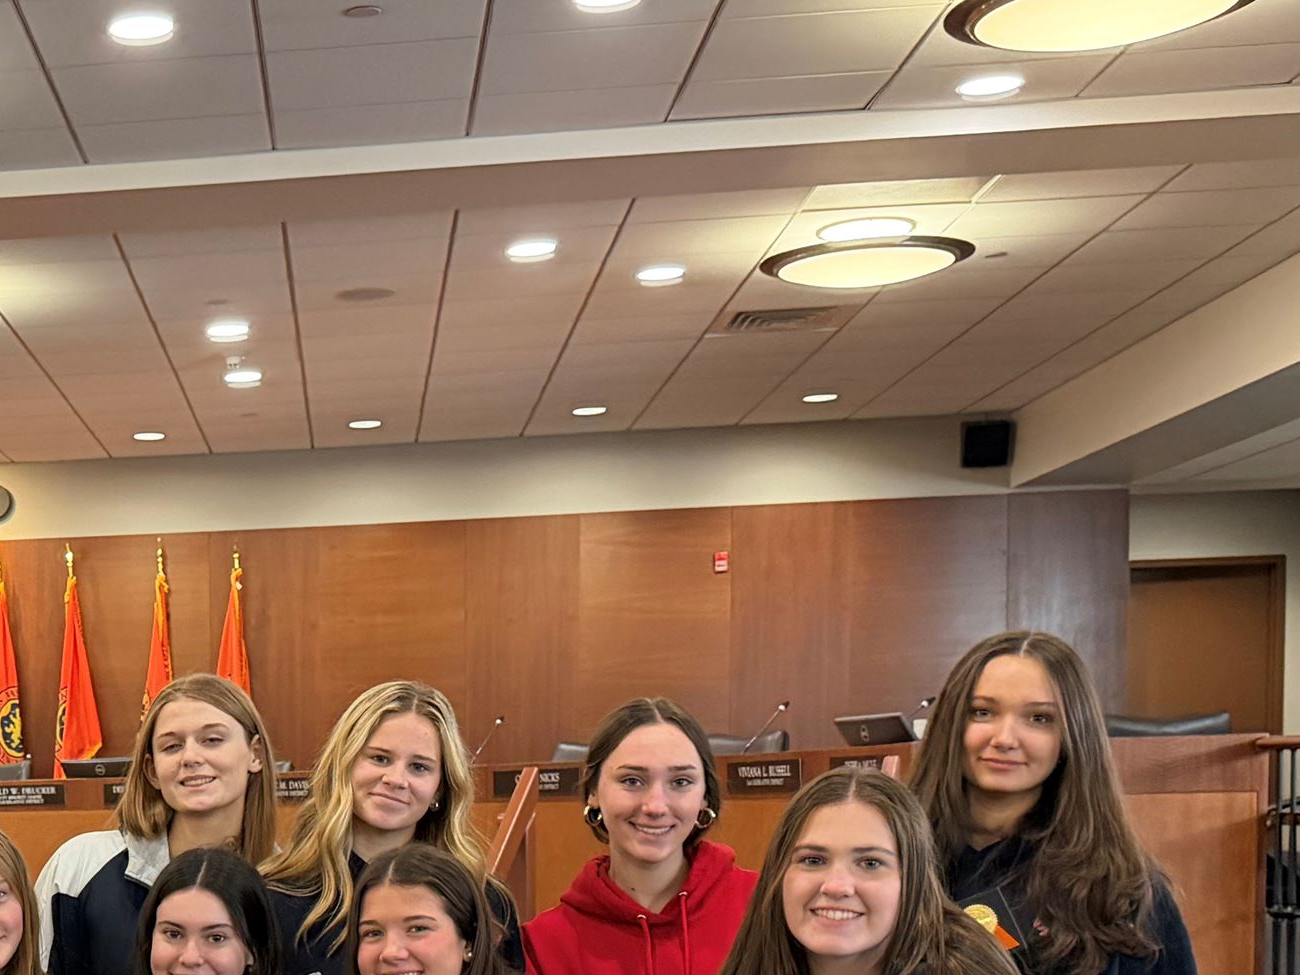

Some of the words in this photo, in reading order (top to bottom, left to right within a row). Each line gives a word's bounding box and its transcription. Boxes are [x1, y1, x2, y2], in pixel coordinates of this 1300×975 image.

[738, 766, 761, 778] VIVIANA
[768, 764, 792, 777] RUSSELL
[10, 787, 20, 795] W.
[21, 786, 57, 795] DRUCKER
